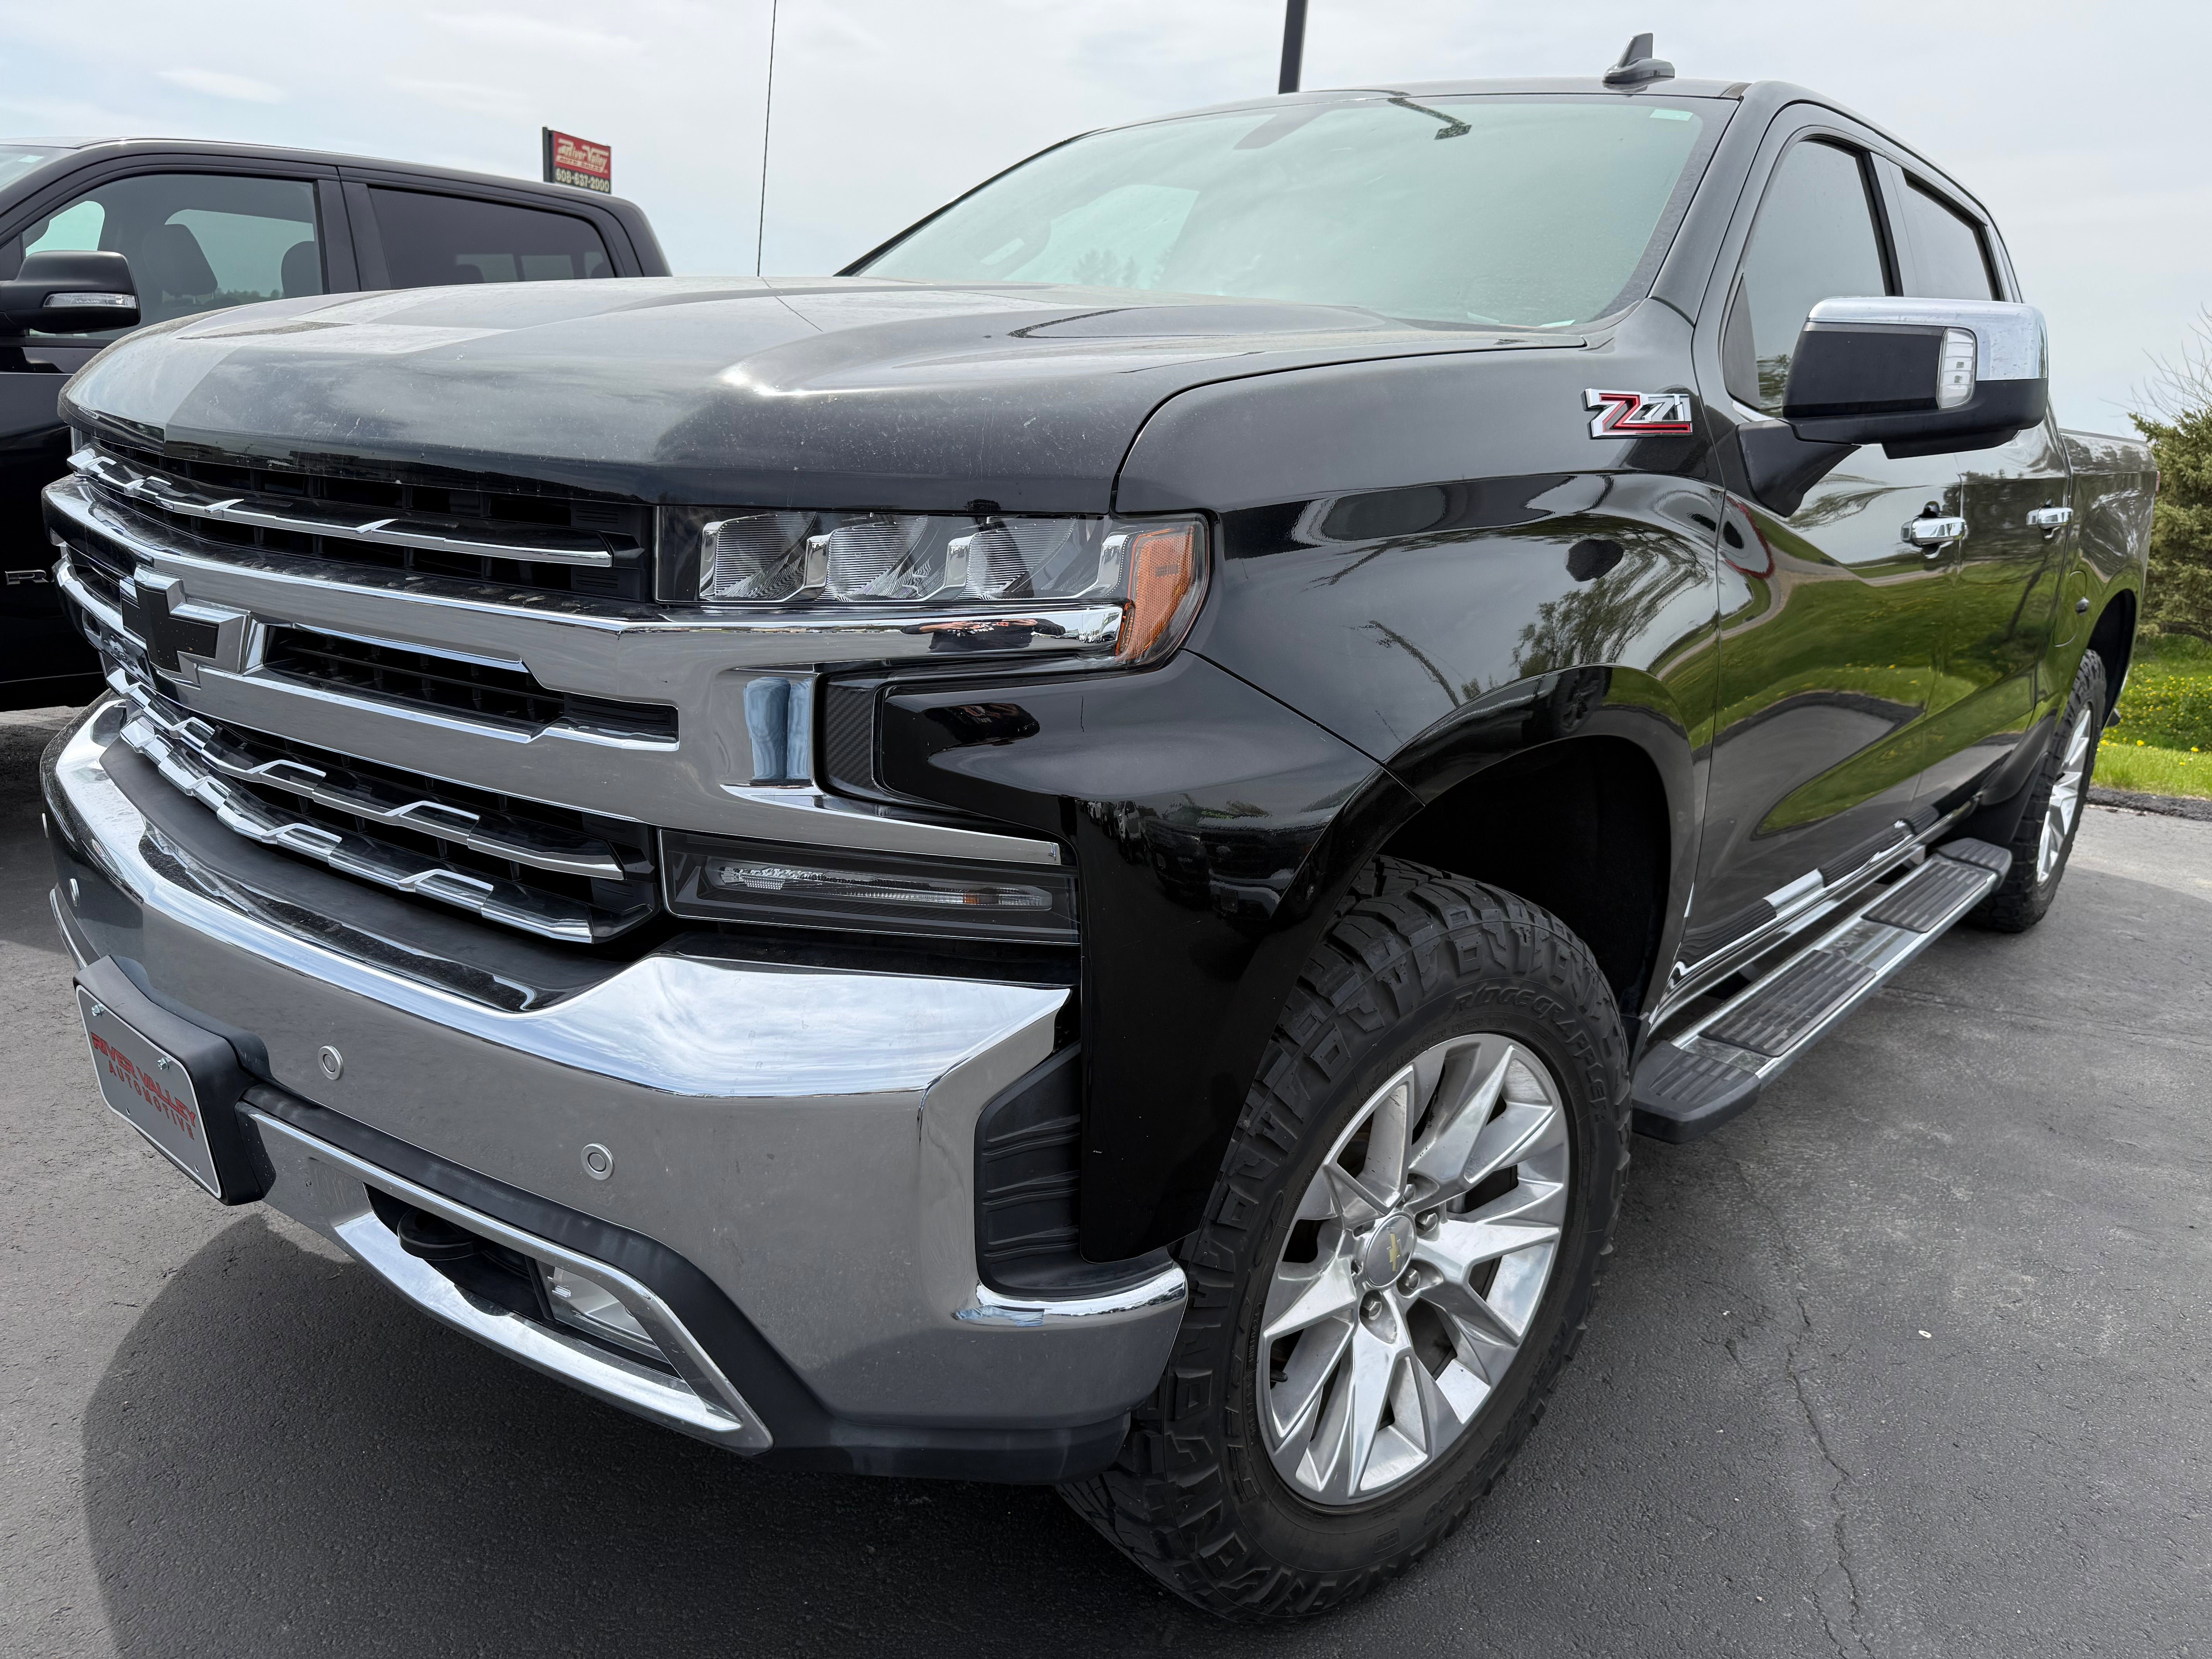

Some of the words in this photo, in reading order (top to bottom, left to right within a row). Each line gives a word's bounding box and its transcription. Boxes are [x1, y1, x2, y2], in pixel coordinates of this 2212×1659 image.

[555, 167, 610, 193] 608-637-2000
[1580, 388, 1692, 440] Z71
[90, 1031, 138, 1080] RIVER
[136, 1066, 196, 1128] VALLEY
[108, 1060, 194, 1140] AUTOMOTIVE
